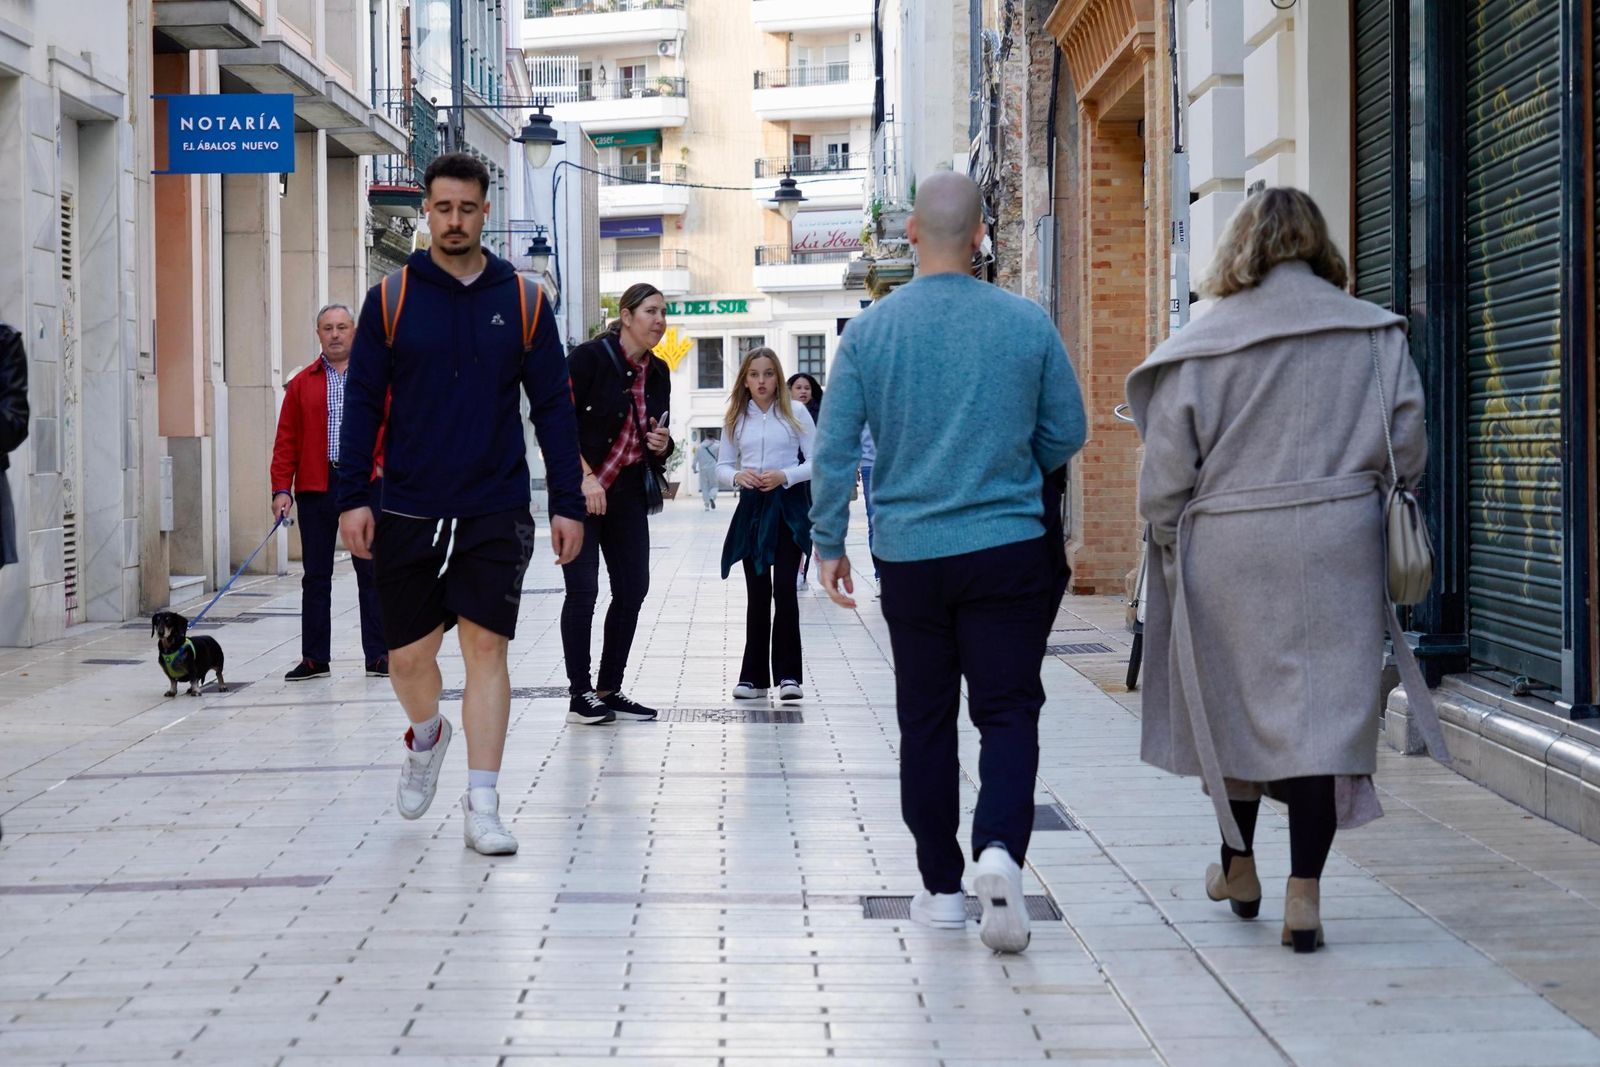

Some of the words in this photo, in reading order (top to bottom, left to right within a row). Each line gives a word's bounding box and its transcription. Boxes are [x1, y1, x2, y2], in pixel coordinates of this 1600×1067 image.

[180, 112, 281, 131] NOTARÍA
[197, 140, 237, 151] ÁBALOS
[242, 141, 279, 150] NUEVO
[684, 301, 714, 315] DEL
[716, 299, 748, 314] SUR
